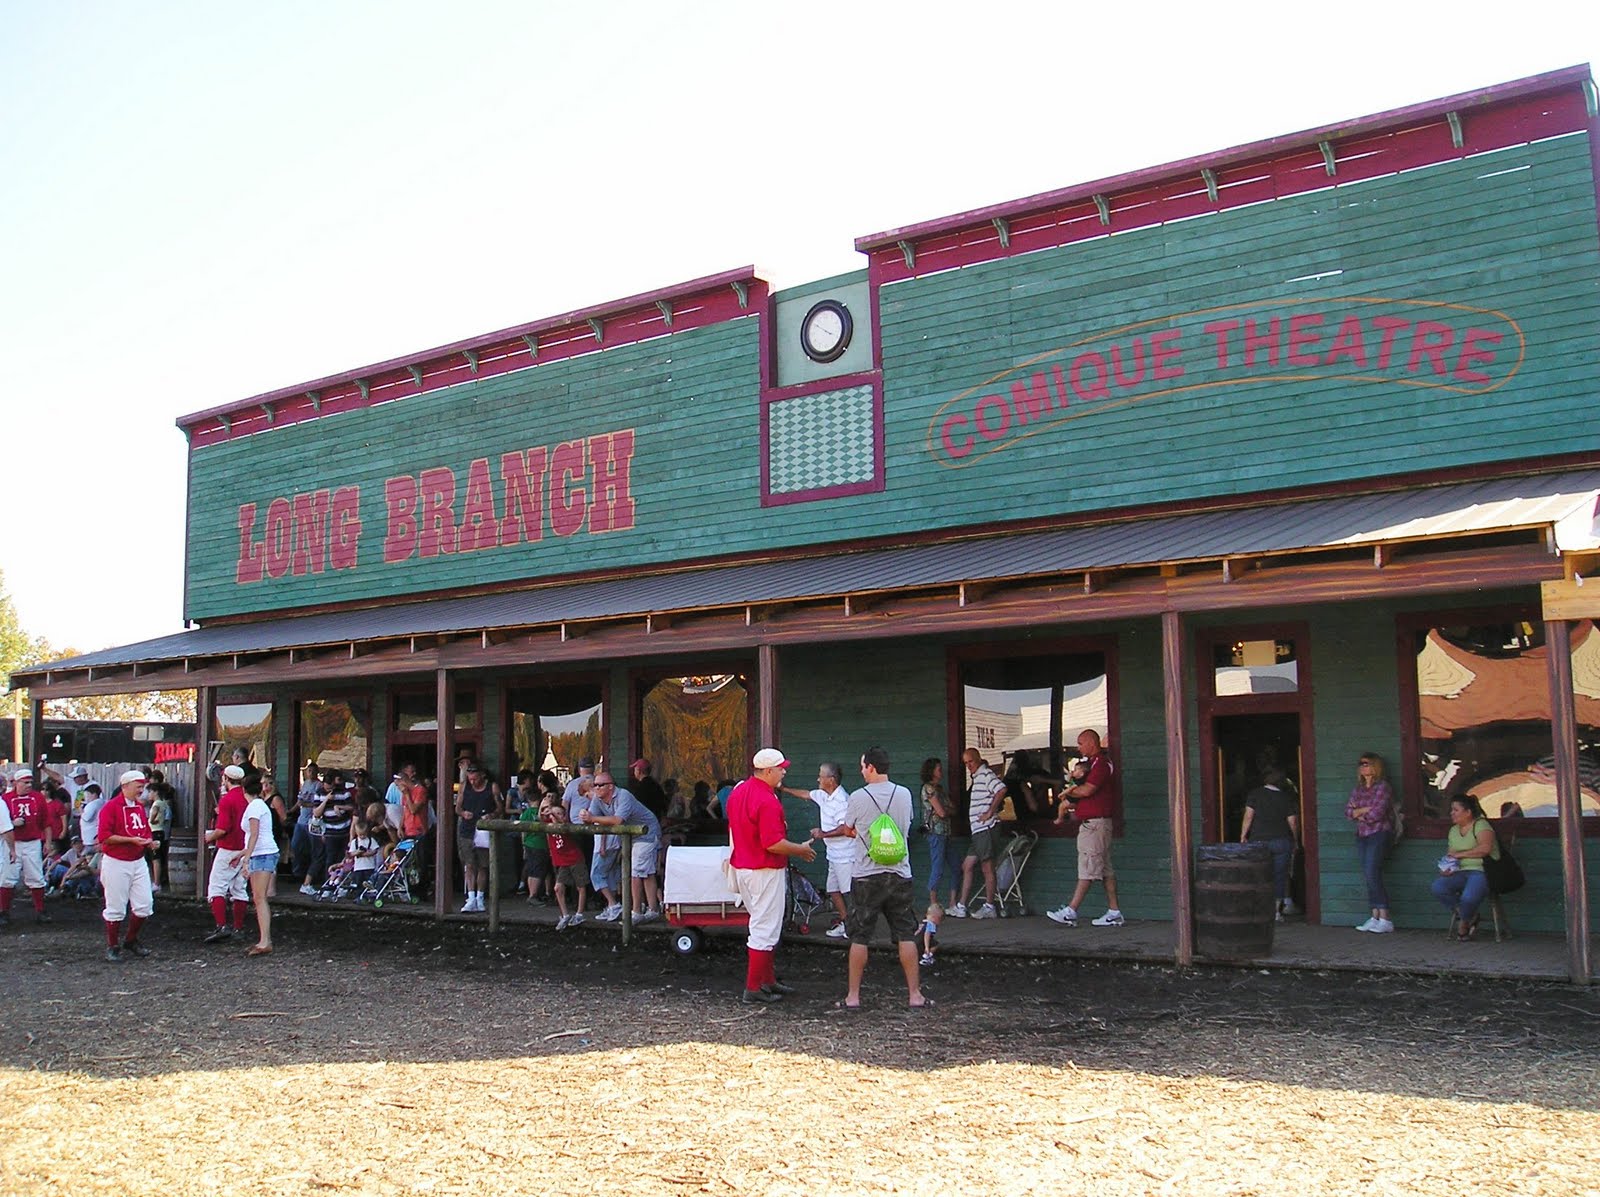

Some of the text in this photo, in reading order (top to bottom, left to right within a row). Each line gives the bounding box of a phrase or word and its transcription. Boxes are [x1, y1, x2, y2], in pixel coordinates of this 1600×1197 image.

[940, 313, 1504, 459] COMIQUE THEATRE
[236, 428, 636, 584] LONG BRANCH
